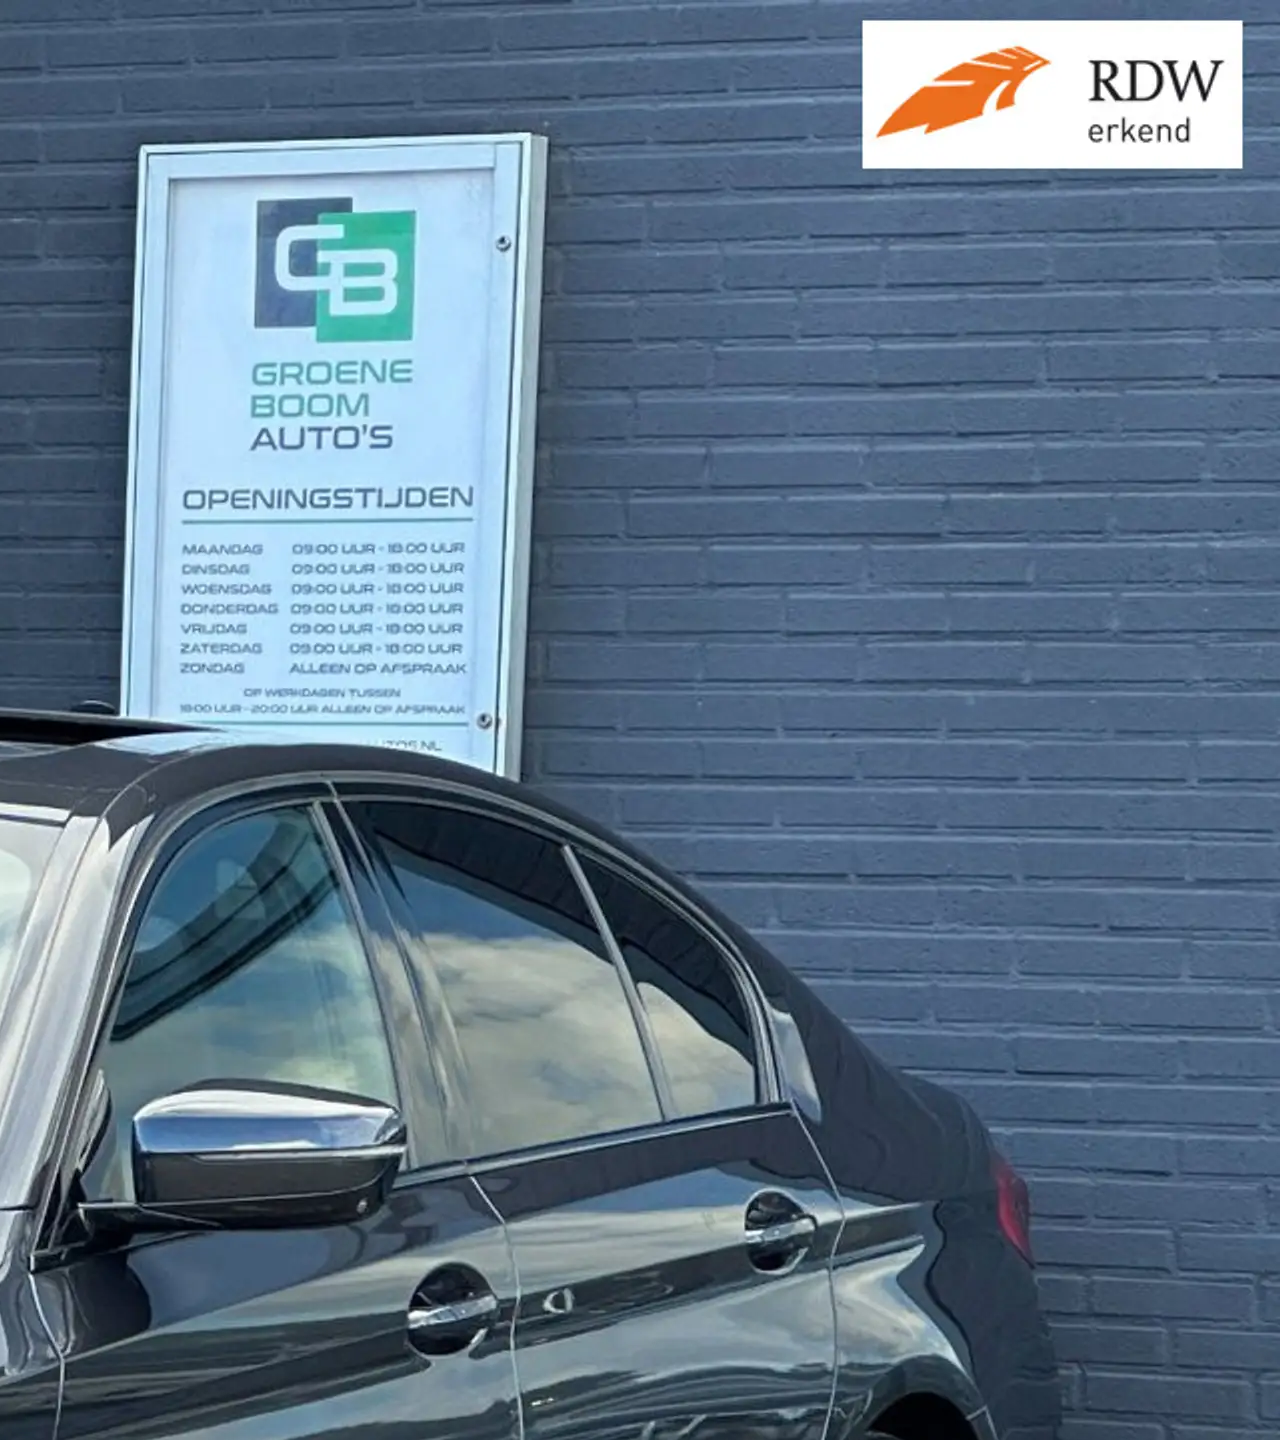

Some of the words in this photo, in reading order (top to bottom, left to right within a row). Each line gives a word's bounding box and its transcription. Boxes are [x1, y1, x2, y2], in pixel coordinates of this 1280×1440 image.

[252, 359, 413, 386] GROENE
[250, 393, 370, 418] BOOM
[250, 425, 393, 451] AUTO'S
[182, 486, 474, 510] OPENINGSTIJDEN
[181, 543, 264, 556] MAANDAG
[341, 543, 375, 555] UUR
[430, 542, 466, 554] UUR
[181, 563, 251, 575] DINSDAG
[341, 563, 375, 575] UUR
[430, 562, 466, 574] UUR
[181, 583, 273, 595] WOENSDAG
[340, 583, 374, 595] UUR
[429, 582, 465, 594] UUR
[180, 603, 279, 615] DONDERDAG
[340, 603, 374, 615] UUR
[429, 602, 465, 614] UUR
[180, 623, 248, 635] VRIJDAG
[340, 623, 374, 635] UUR
[429, 622, 465, 634] UUR
[179, 643, 263, 654] ZATERDAG
[339, 643, 373, 655] UUR
[428, 642, 464, 654] UUR
[179, 663, 245, 674] ZONDAG
[289, 663, 351, 675] ALLEEN
[354, 663, 377, 674] OP
[380, 663, 467, 674] AFSPRAAK
